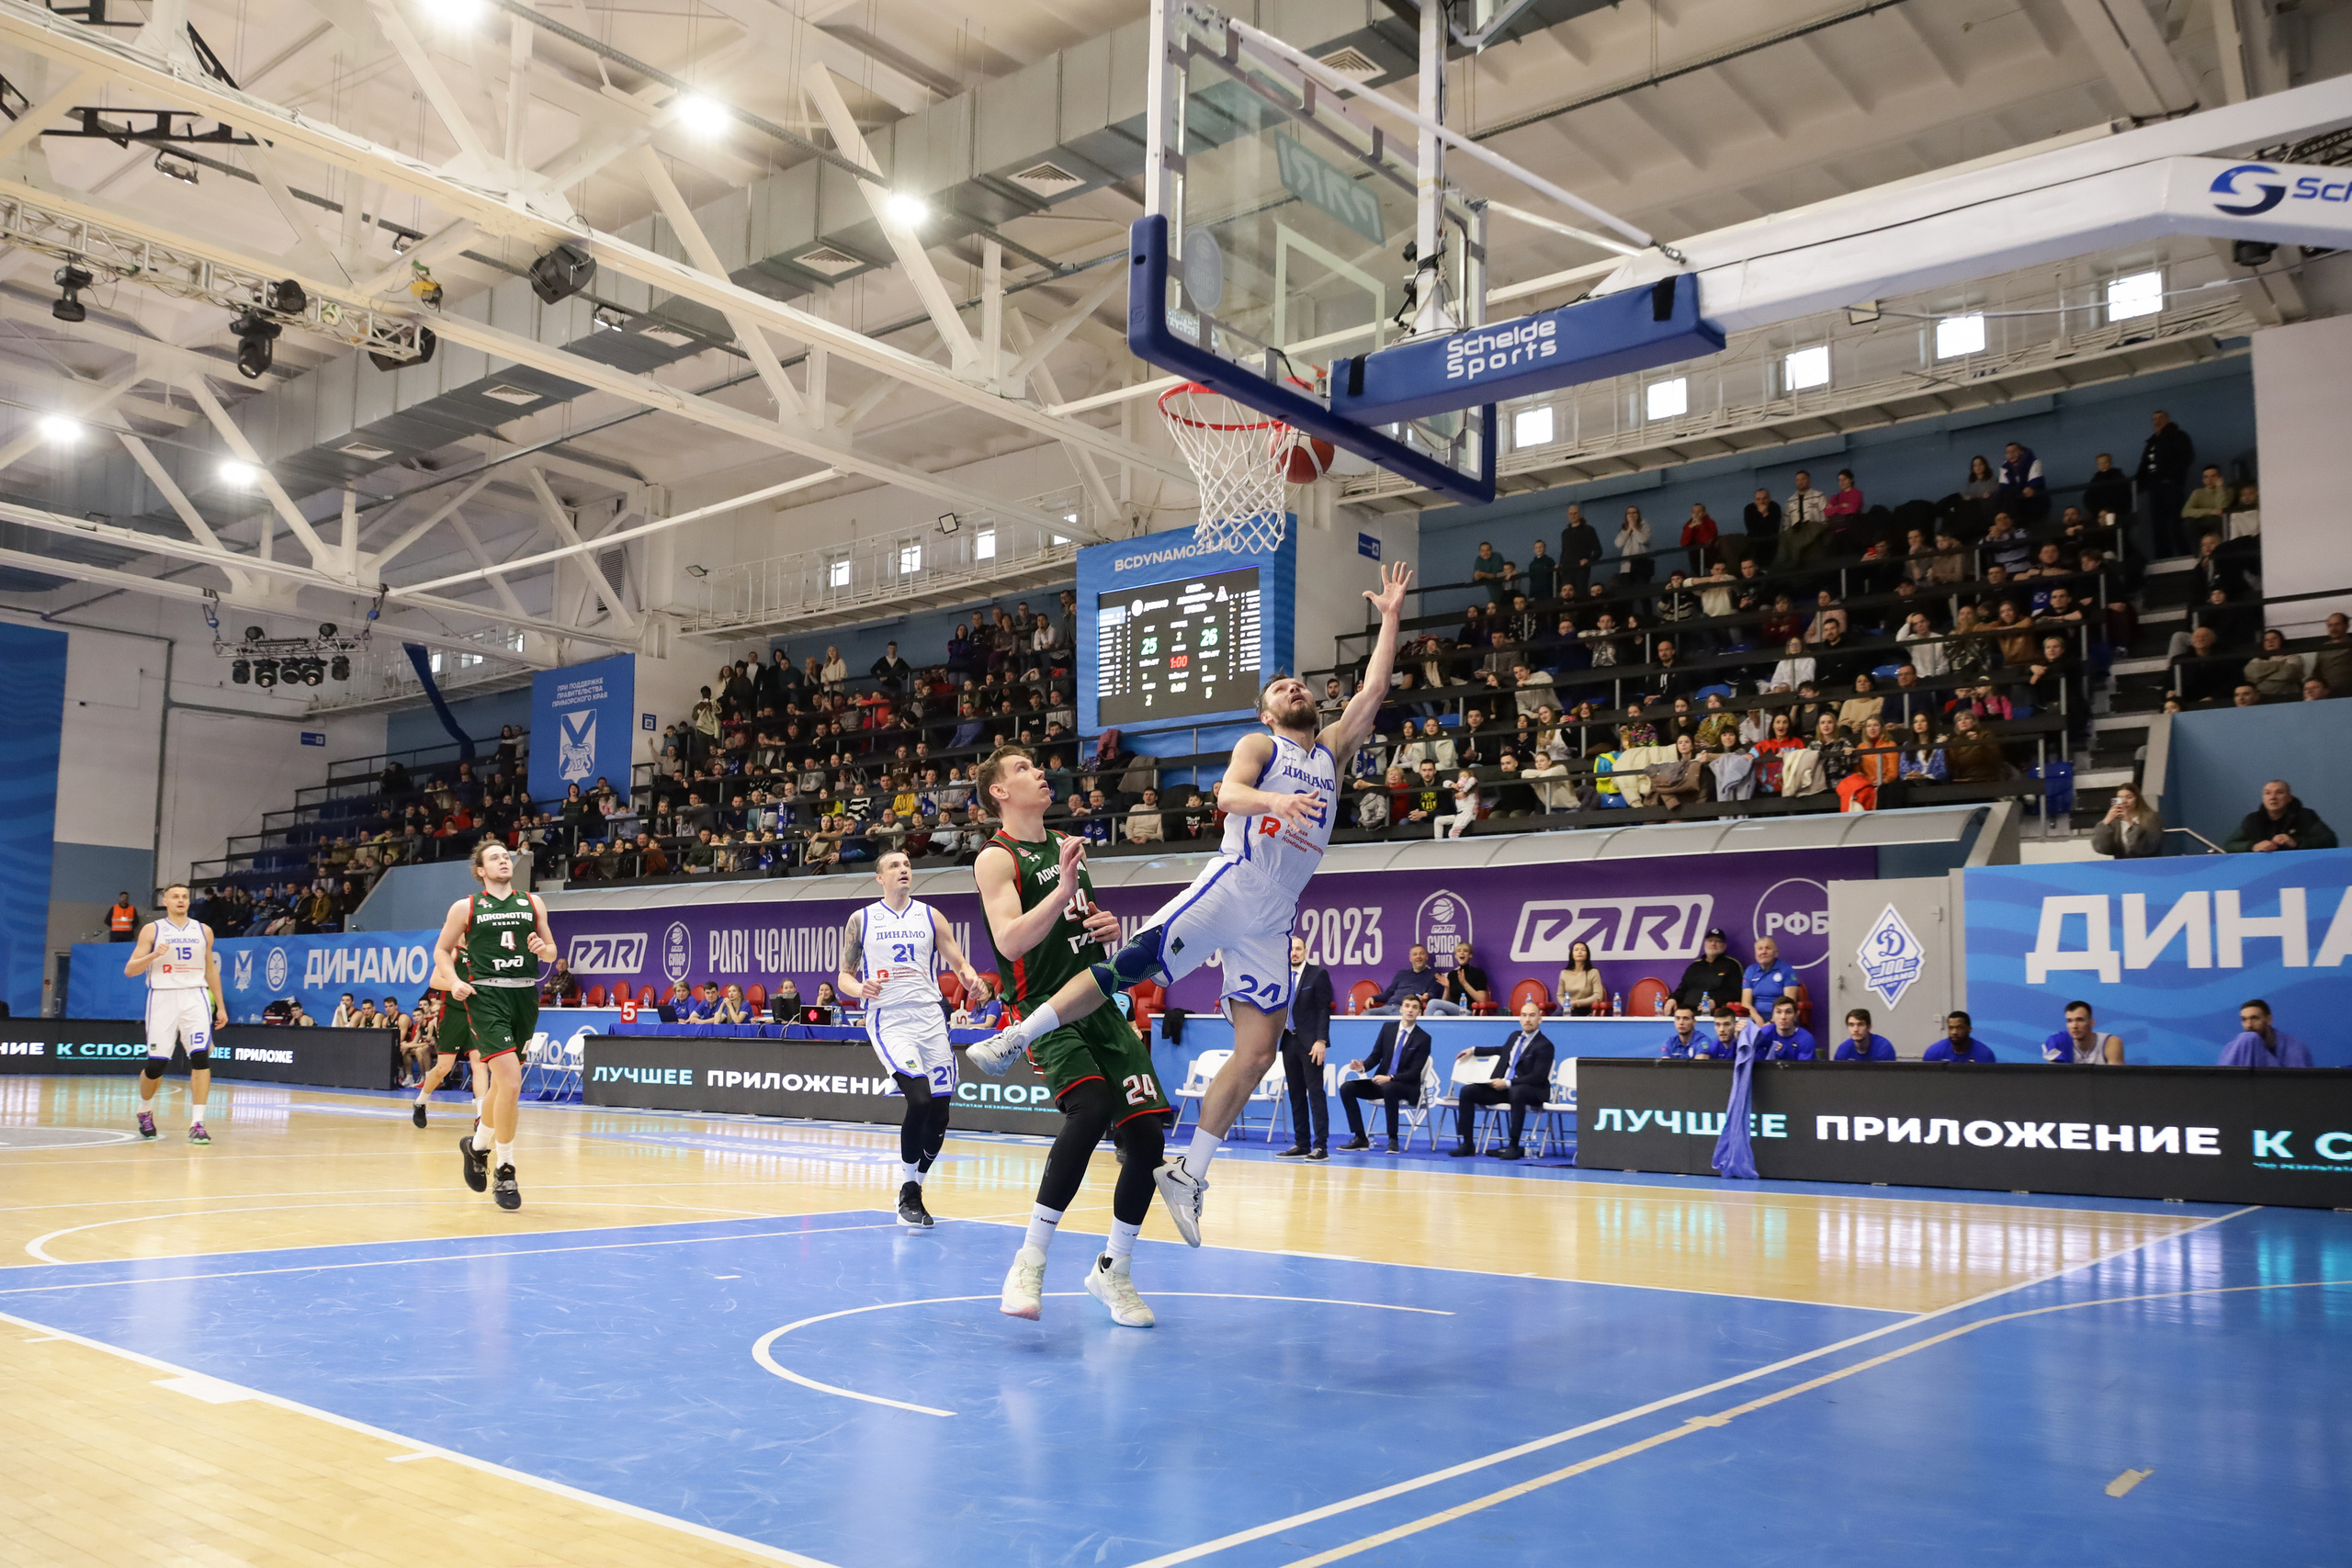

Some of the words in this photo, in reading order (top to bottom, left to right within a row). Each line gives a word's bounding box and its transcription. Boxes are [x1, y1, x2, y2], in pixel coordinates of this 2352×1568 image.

[1447, 320, 1556, 360] Schelde
[1447, 339, 1557, 380] Sports
[1141, 637, 1158, 655] 25
[1200, 627, 1218, 647] 26
[1170, 655, 1189, 669] 1:00
[1283, 765, 1335, 792] ДИНАМО
[476, 912, 533, 924] ЛОКОМОТИВ
[1519, 903, 1702, 953] PARI
[1765, 910, 1828, 935] РФБ
[500, 931, 516, 951] 4
[876, 931, 926, 941] ДИНАМО
[1301, 907, 1383, 965] 2023
[175, 947, 192, 960] 15
[569, 938, 644, 969] PARI
[709, 929, 748, 973] PARI
[754, 926, 845, 973] ЧЕМПИО
[892, 943, 915, 963] 21
[303, 945, 428, 989] ДИНАМО
[623, 1001, 636, 1021] 5
[190, 1032, 204, 1045] 15
[57, 1043, 74, 1055] К
[79, 1043, 149, 1055] СПОР
[235, 1047, 294, 1064] ПРИЛОЖЕ
[593, 1066, 694, 1086] ЛУЧШЕЕ
[707, 1070, 891, 1096] ПРИЛОЖЕНИ
[957, 1082, 1051, 1104] СПОР
[933, 1066, 953, 1086] 21
[1122, 1074, 1159, 1106] 24
[1815, 1114, 2222, 1156] ПРИЛОЖЕНИЕ
[2253, 1130, 2295, 1157] К
